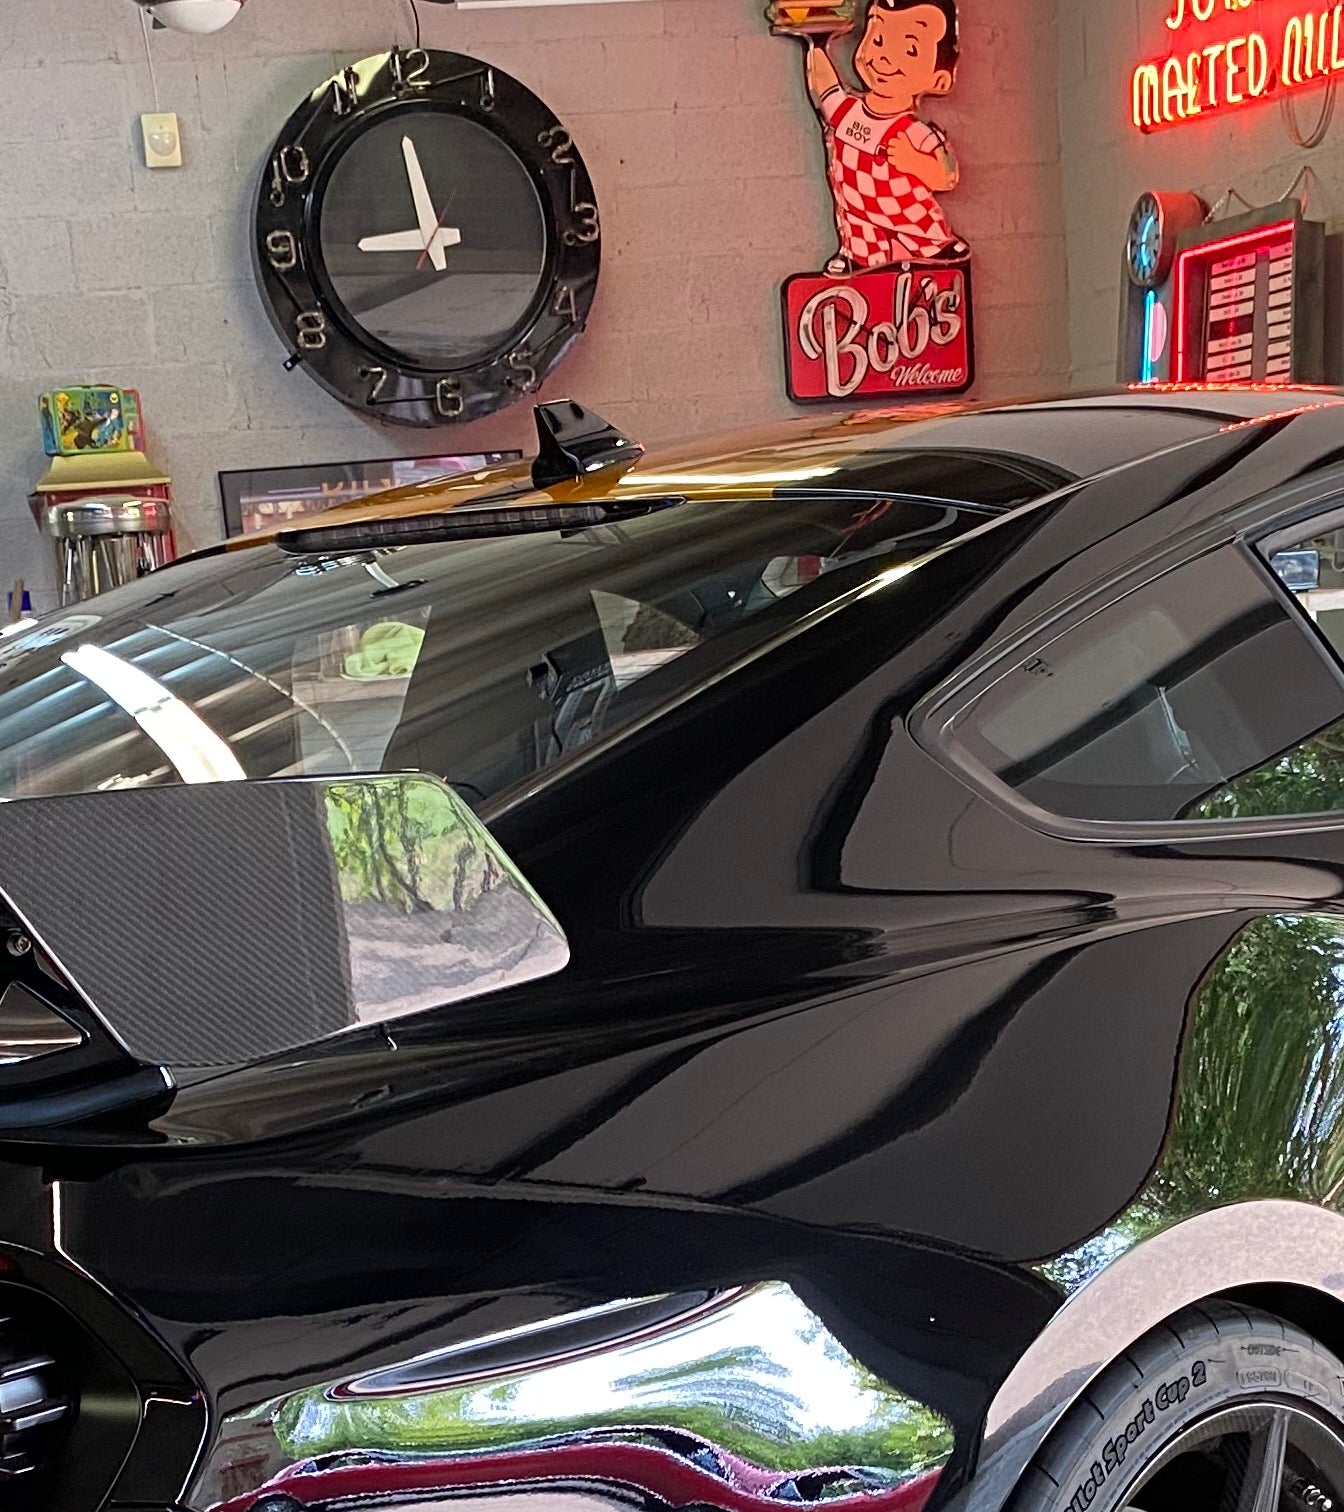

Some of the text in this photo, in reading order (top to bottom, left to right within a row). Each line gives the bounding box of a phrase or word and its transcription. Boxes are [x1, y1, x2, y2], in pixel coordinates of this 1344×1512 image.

[392, 49, 432, 88] 12
[1132, 33, 1268, 127] MALTED
[846, 127, 871, 144] BOY
[852, 121, 871, 135] BIG
[570, 202, 599, 243] 3
[266, 230, 297, 271] 9
[296, 311, 326, 349] 8
[799, 272, 961, 397] Bob's
[889, 364, 962, 388] Welcome
[436, 377, 464, 417] 6
[1102, 1398, 1155, 1476] Sport
[1156, 1377, 1190, 1411] Cup
[1191, 1360, 1207, 1388] 2
